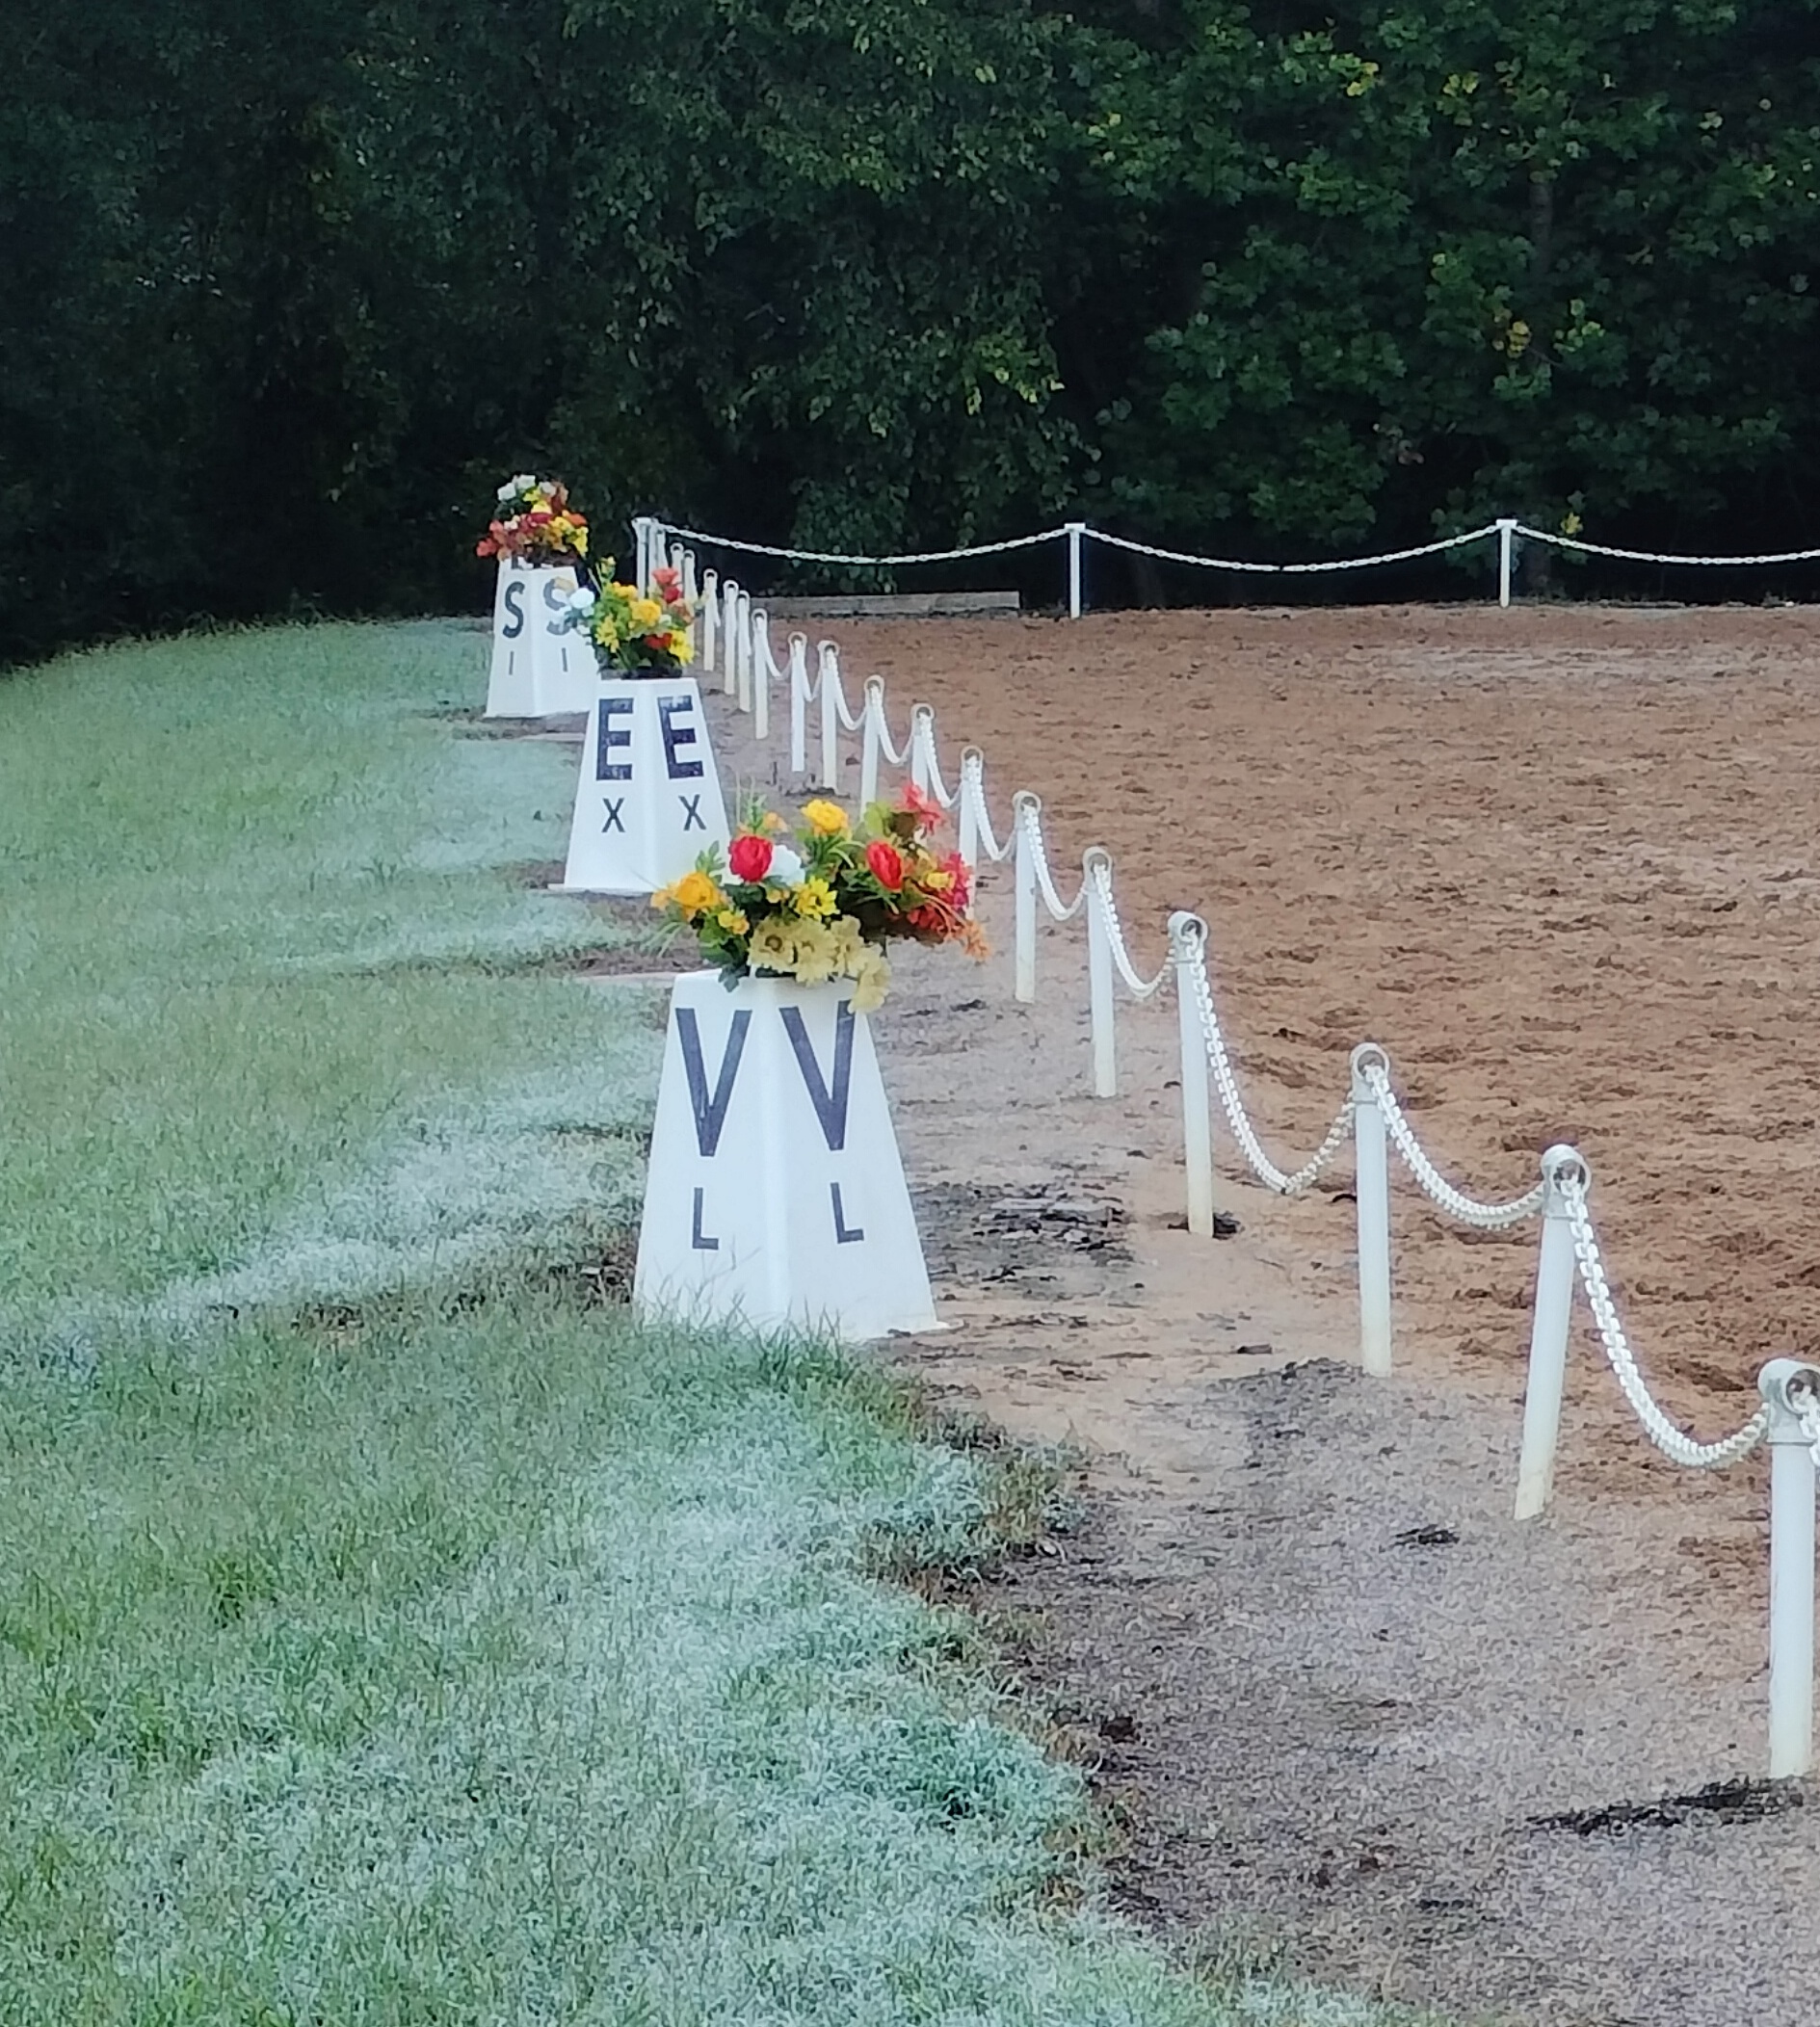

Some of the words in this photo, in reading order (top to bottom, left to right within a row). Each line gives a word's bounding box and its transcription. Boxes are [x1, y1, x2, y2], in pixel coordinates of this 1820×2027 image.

[502, 581, 525, 638] S
[596, 698, 633, 780] E
[657, 695, 703, 778] E
[675, 1008, 752, 1156] V
[778, 1000, 856, 1150] V
[692, 1187, 719, 1250] L
[830, 1182, 864, 1244] L
